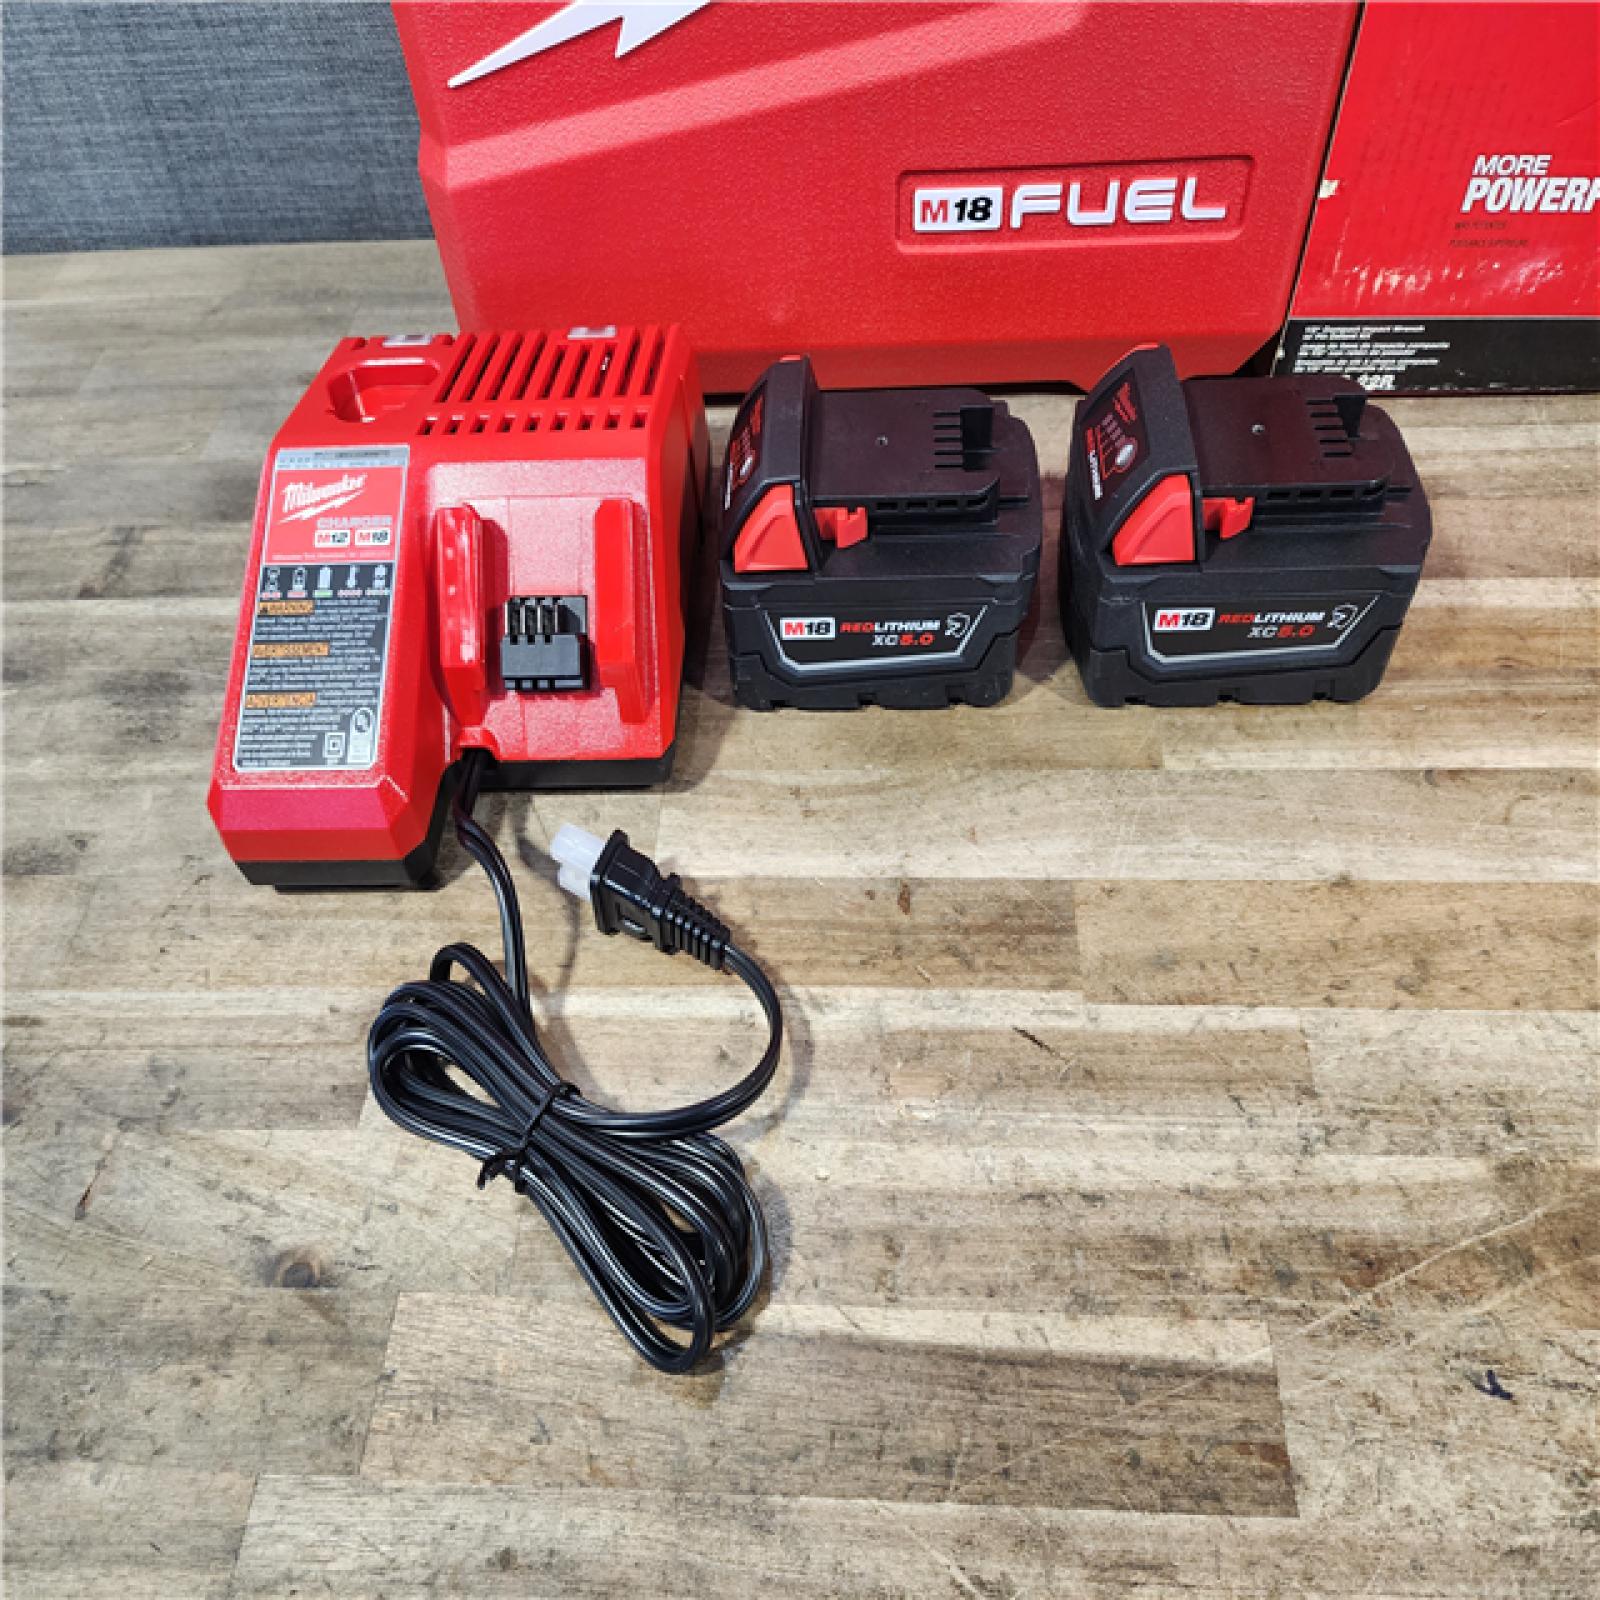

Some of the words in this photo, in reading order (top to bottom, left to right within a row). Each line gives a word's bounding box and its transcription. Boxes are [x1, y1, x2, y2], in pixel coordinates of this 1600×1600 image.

[1472, 154, 1553, 176] MORE
[918, 194, 995, 225] M18
[1009, 176, 1227, 230] FUEL
[783, 620, 832, 637] M18
[839, 619, 942, 634] REDLITHIUM
[1156, 611, 1212, 630] M18
[1216, 610, 1327, 624] REDLITHIUM
